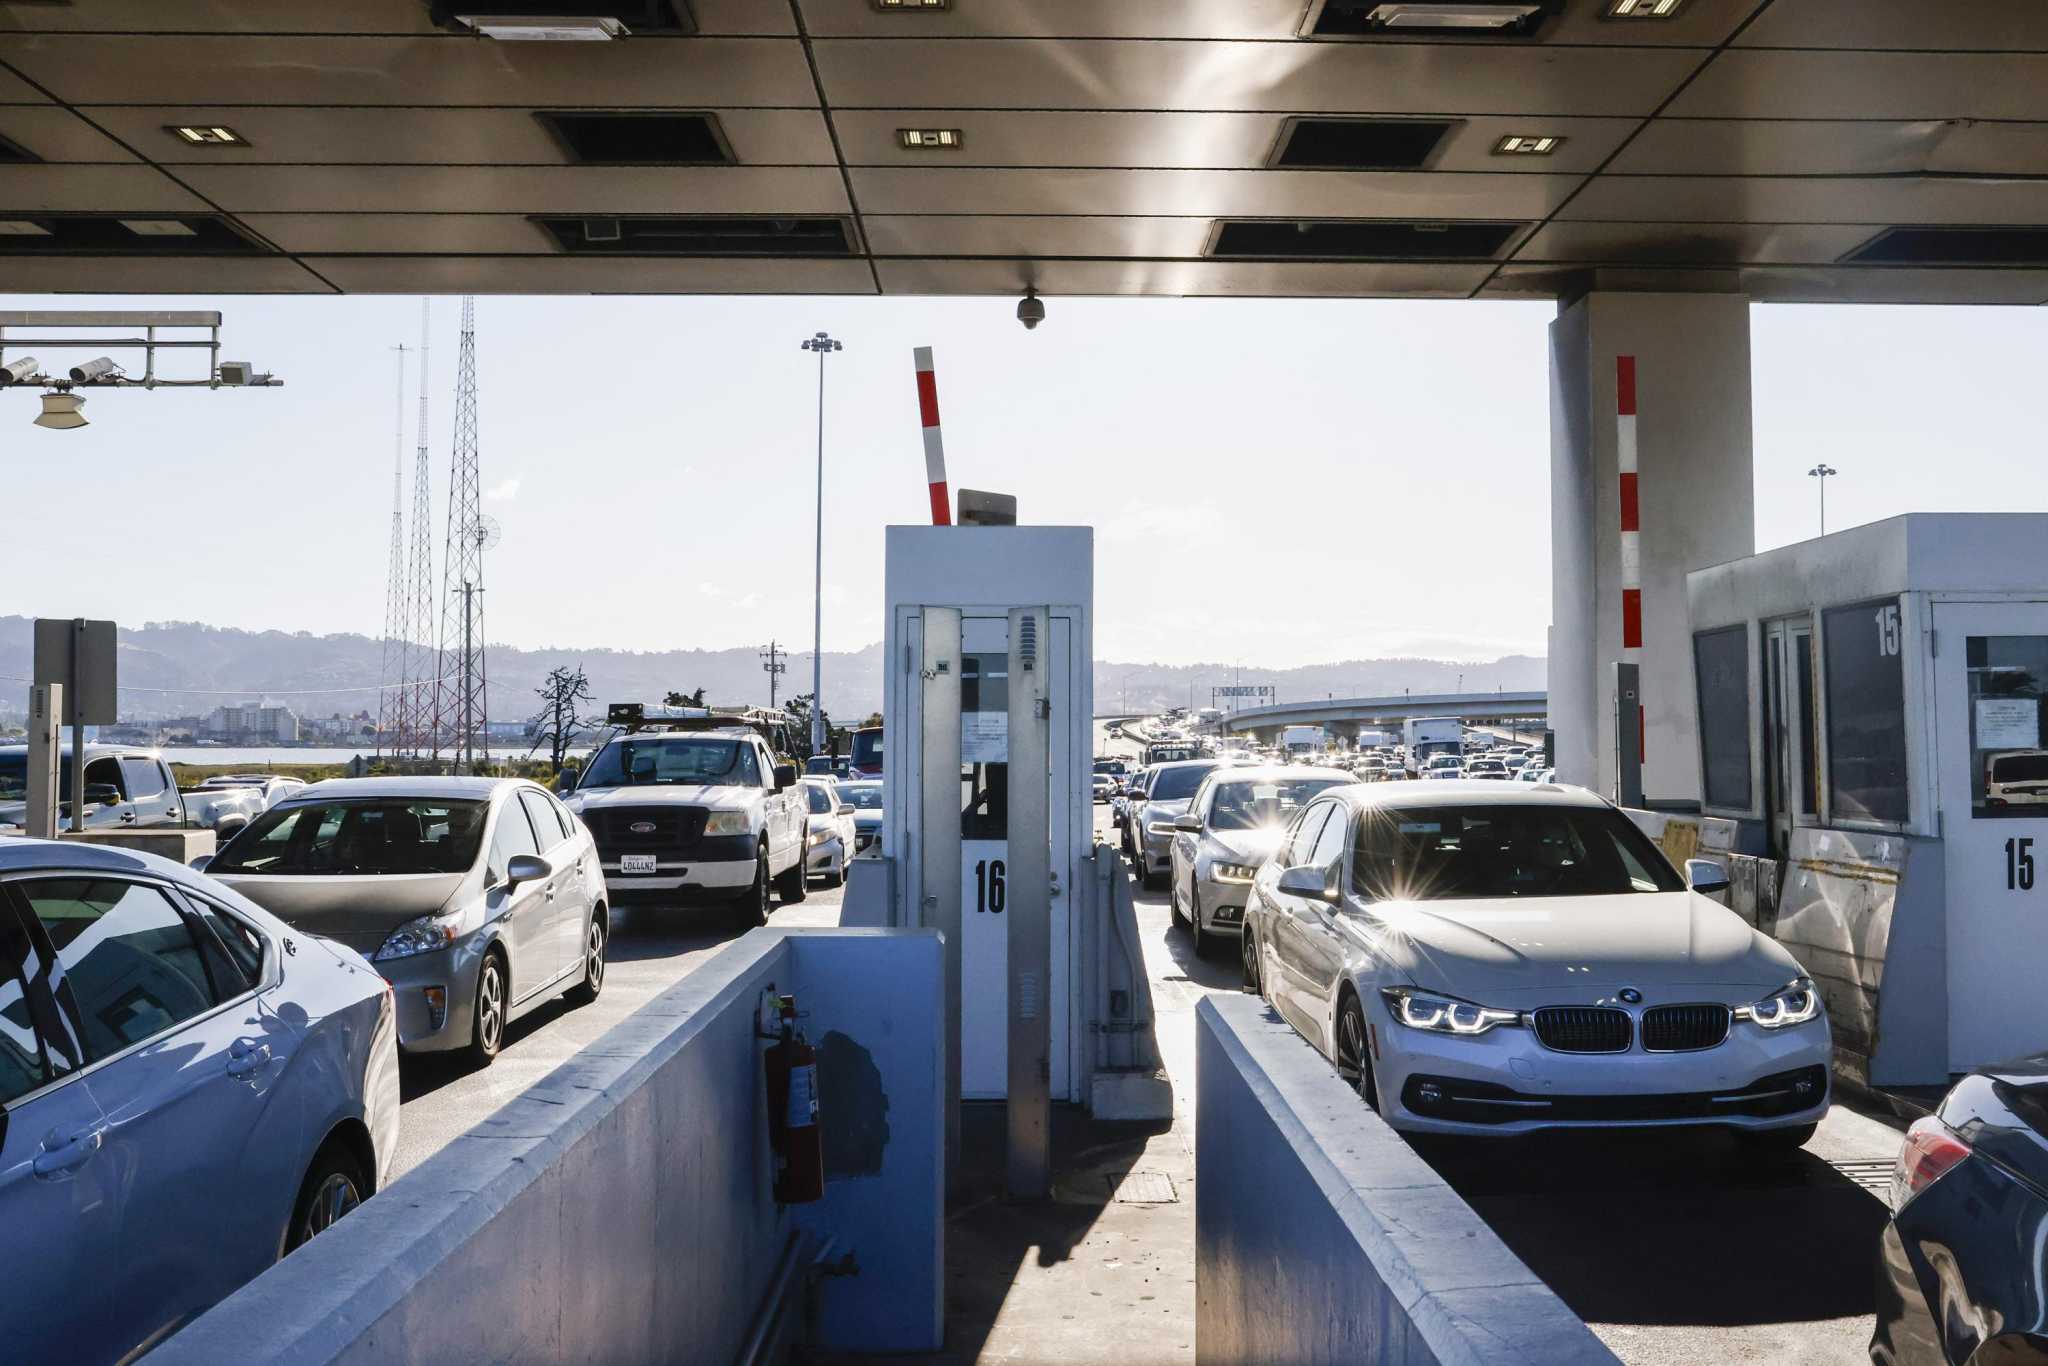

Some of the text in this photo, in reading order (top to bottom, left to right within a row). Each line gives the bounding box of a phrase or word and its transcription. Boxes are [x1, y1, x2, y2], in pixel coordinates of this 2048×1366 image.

[1875, 605, 1899, 656] 15
[976, 860, 1005, 913] 16
[2005, 837, 2034, 890] 15
